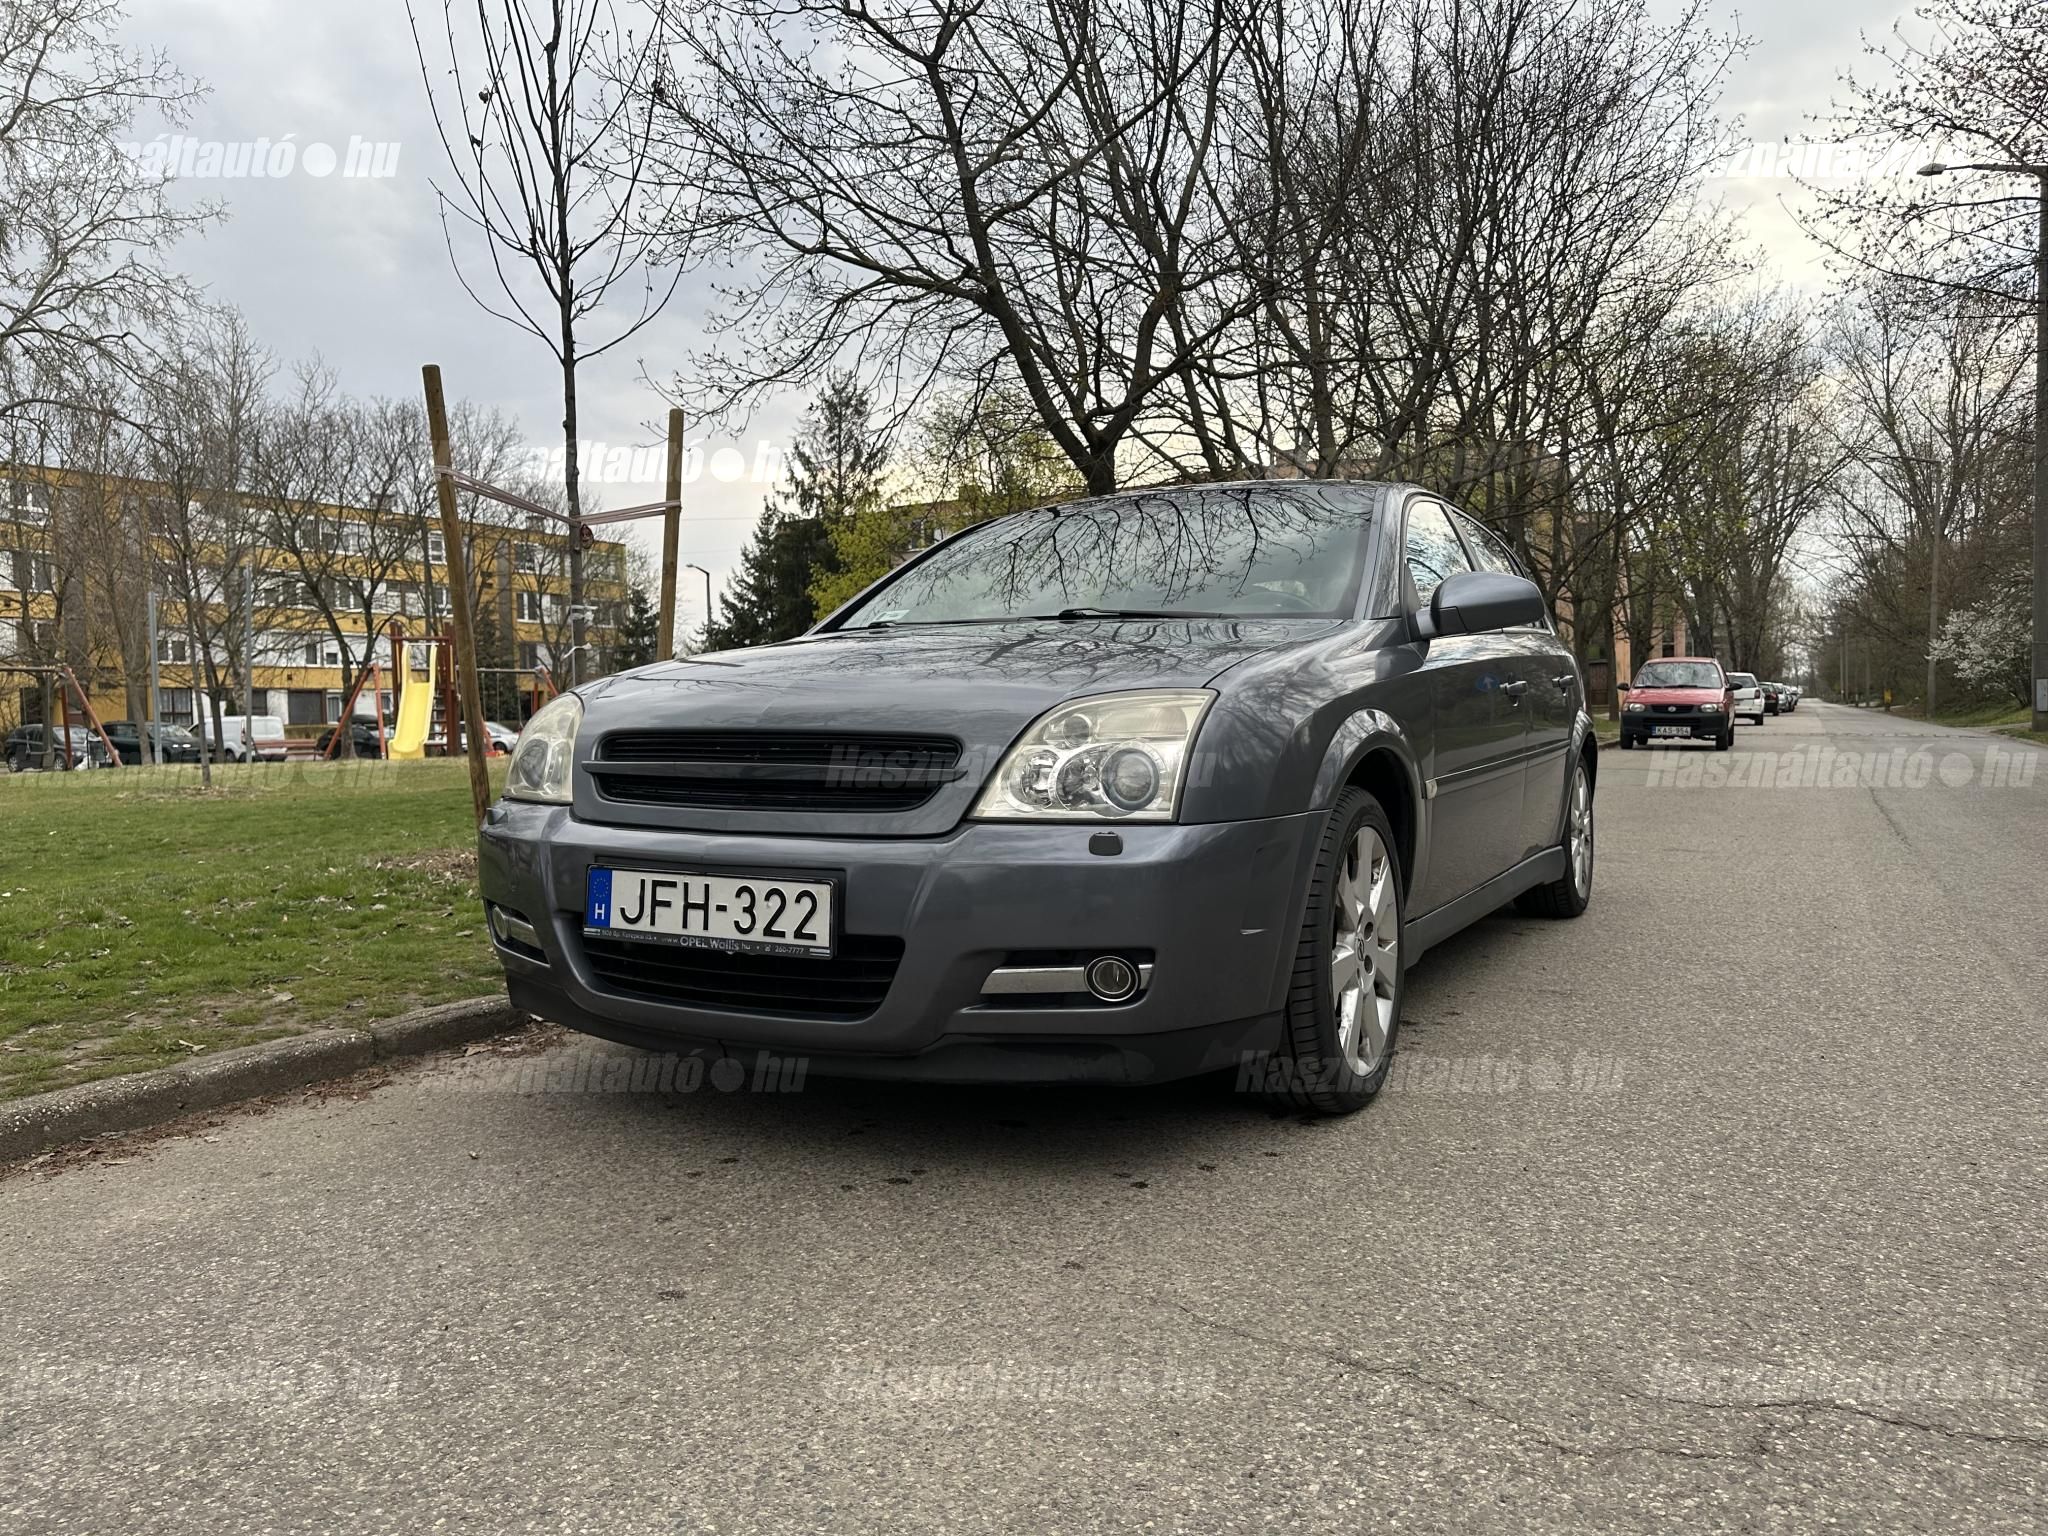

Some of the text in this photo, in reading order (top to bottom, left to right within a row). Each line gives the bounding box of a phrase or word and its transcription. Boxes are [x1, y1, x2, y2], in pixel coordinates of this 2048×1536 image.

[594, 902, 605, 920] H
[619, 878, 818, 941] JFH-322
[680, 936, 708, 948] OPEL
